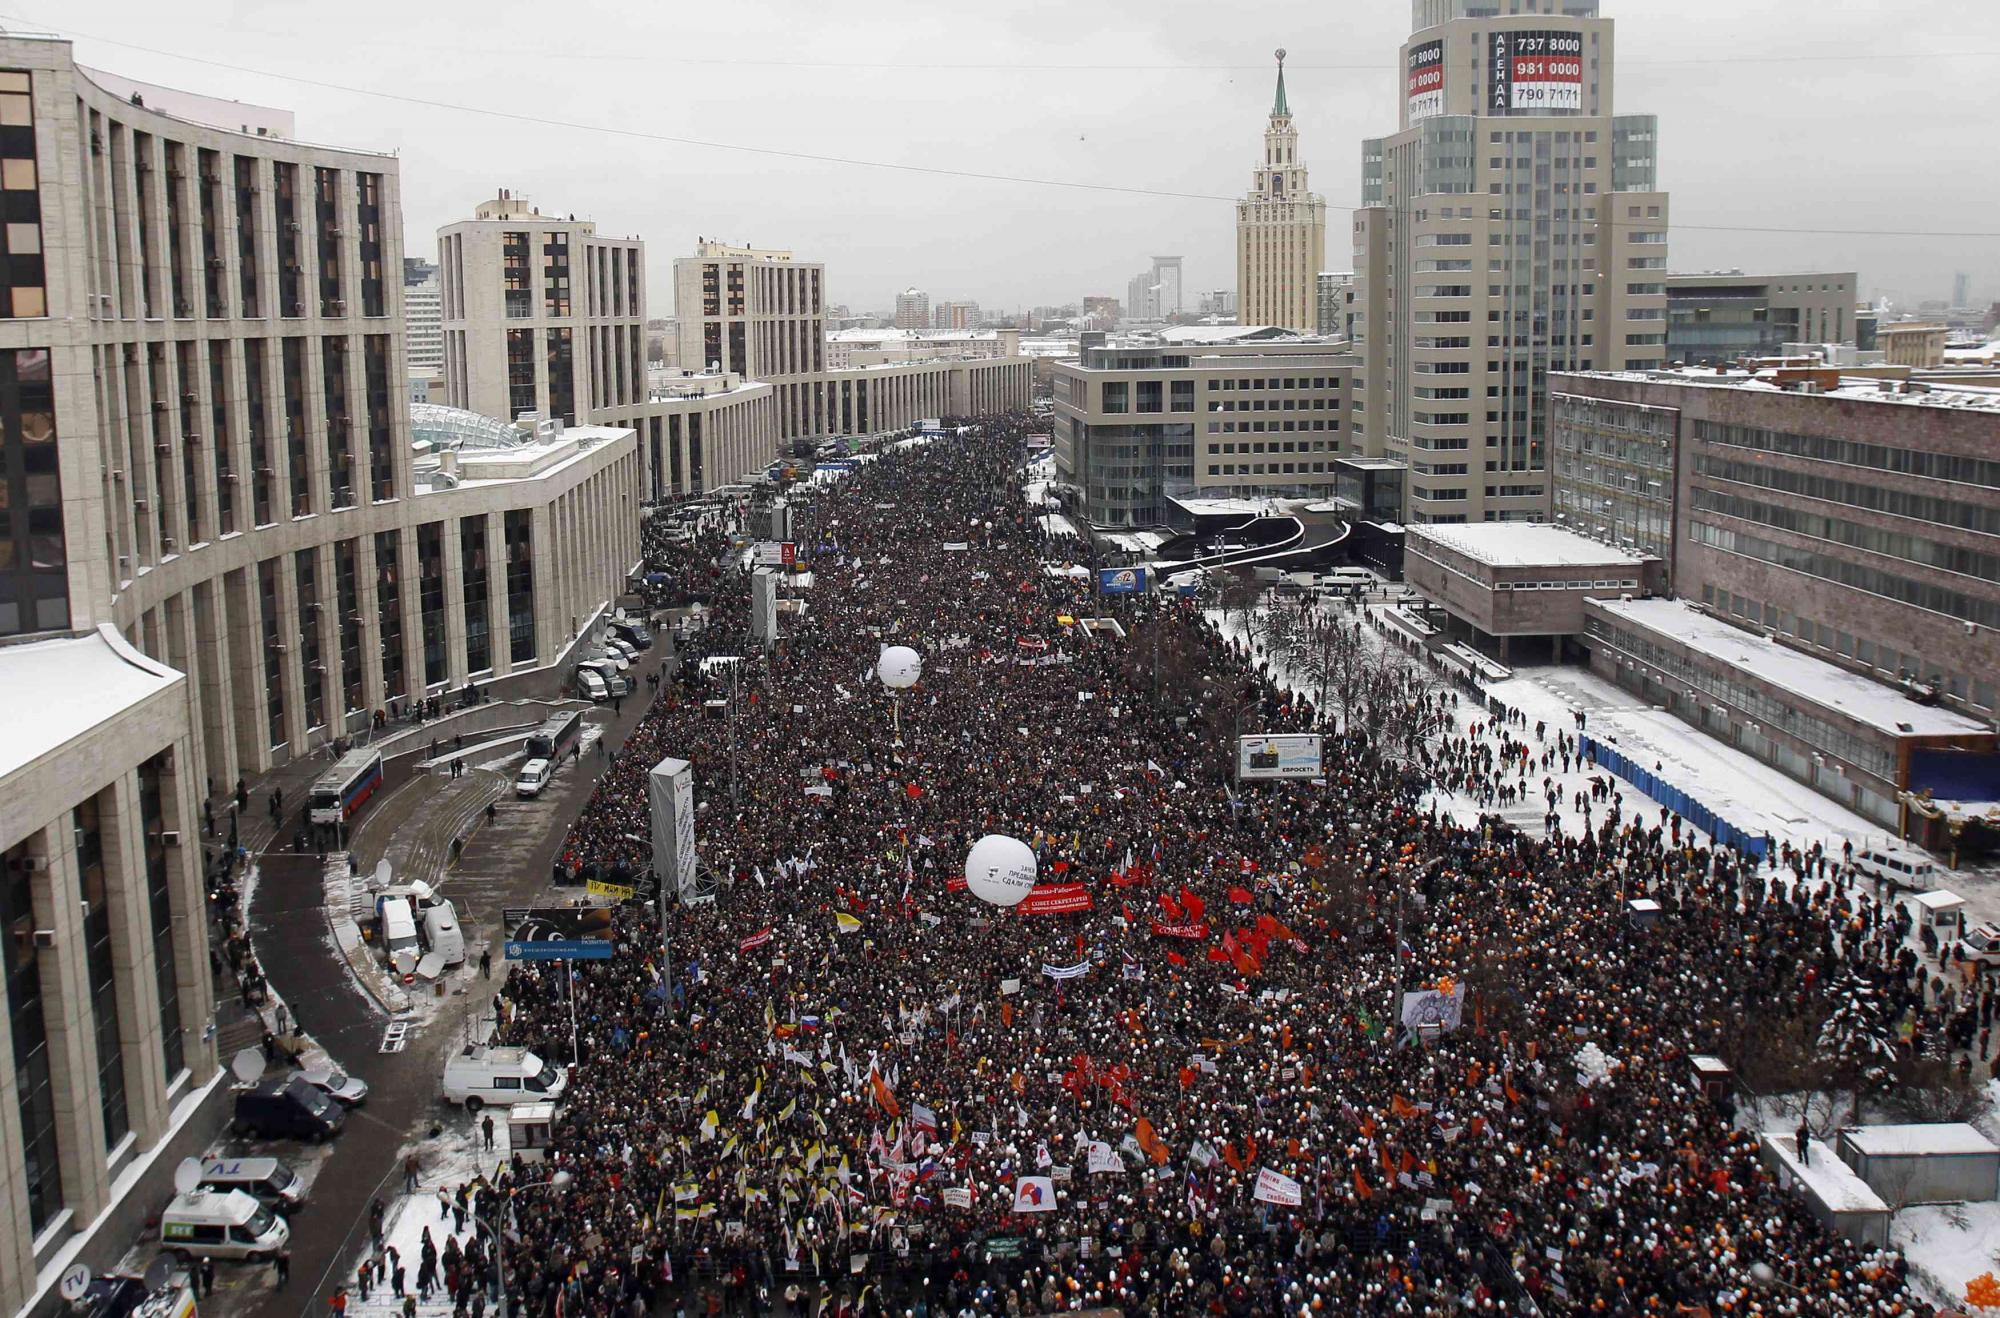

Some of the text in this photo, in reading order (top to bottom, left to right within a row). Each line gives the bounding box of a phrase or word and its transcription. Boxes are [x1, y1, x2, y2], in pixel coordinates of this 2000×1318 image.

[1517, 38, 1580, 52] 737 8000
[1418, 48, 1440, 63] 8000
[1517, 63, 1579, 75] 981 0000
[1418, 71, 1440, 86] 0000
[1517, 89, 1577, 101] 790 7171
[1418, 96, 1439, 111] 7171
[208, 1162, 241, 1175] TV
[65, 1270, 85, 1292] TV
